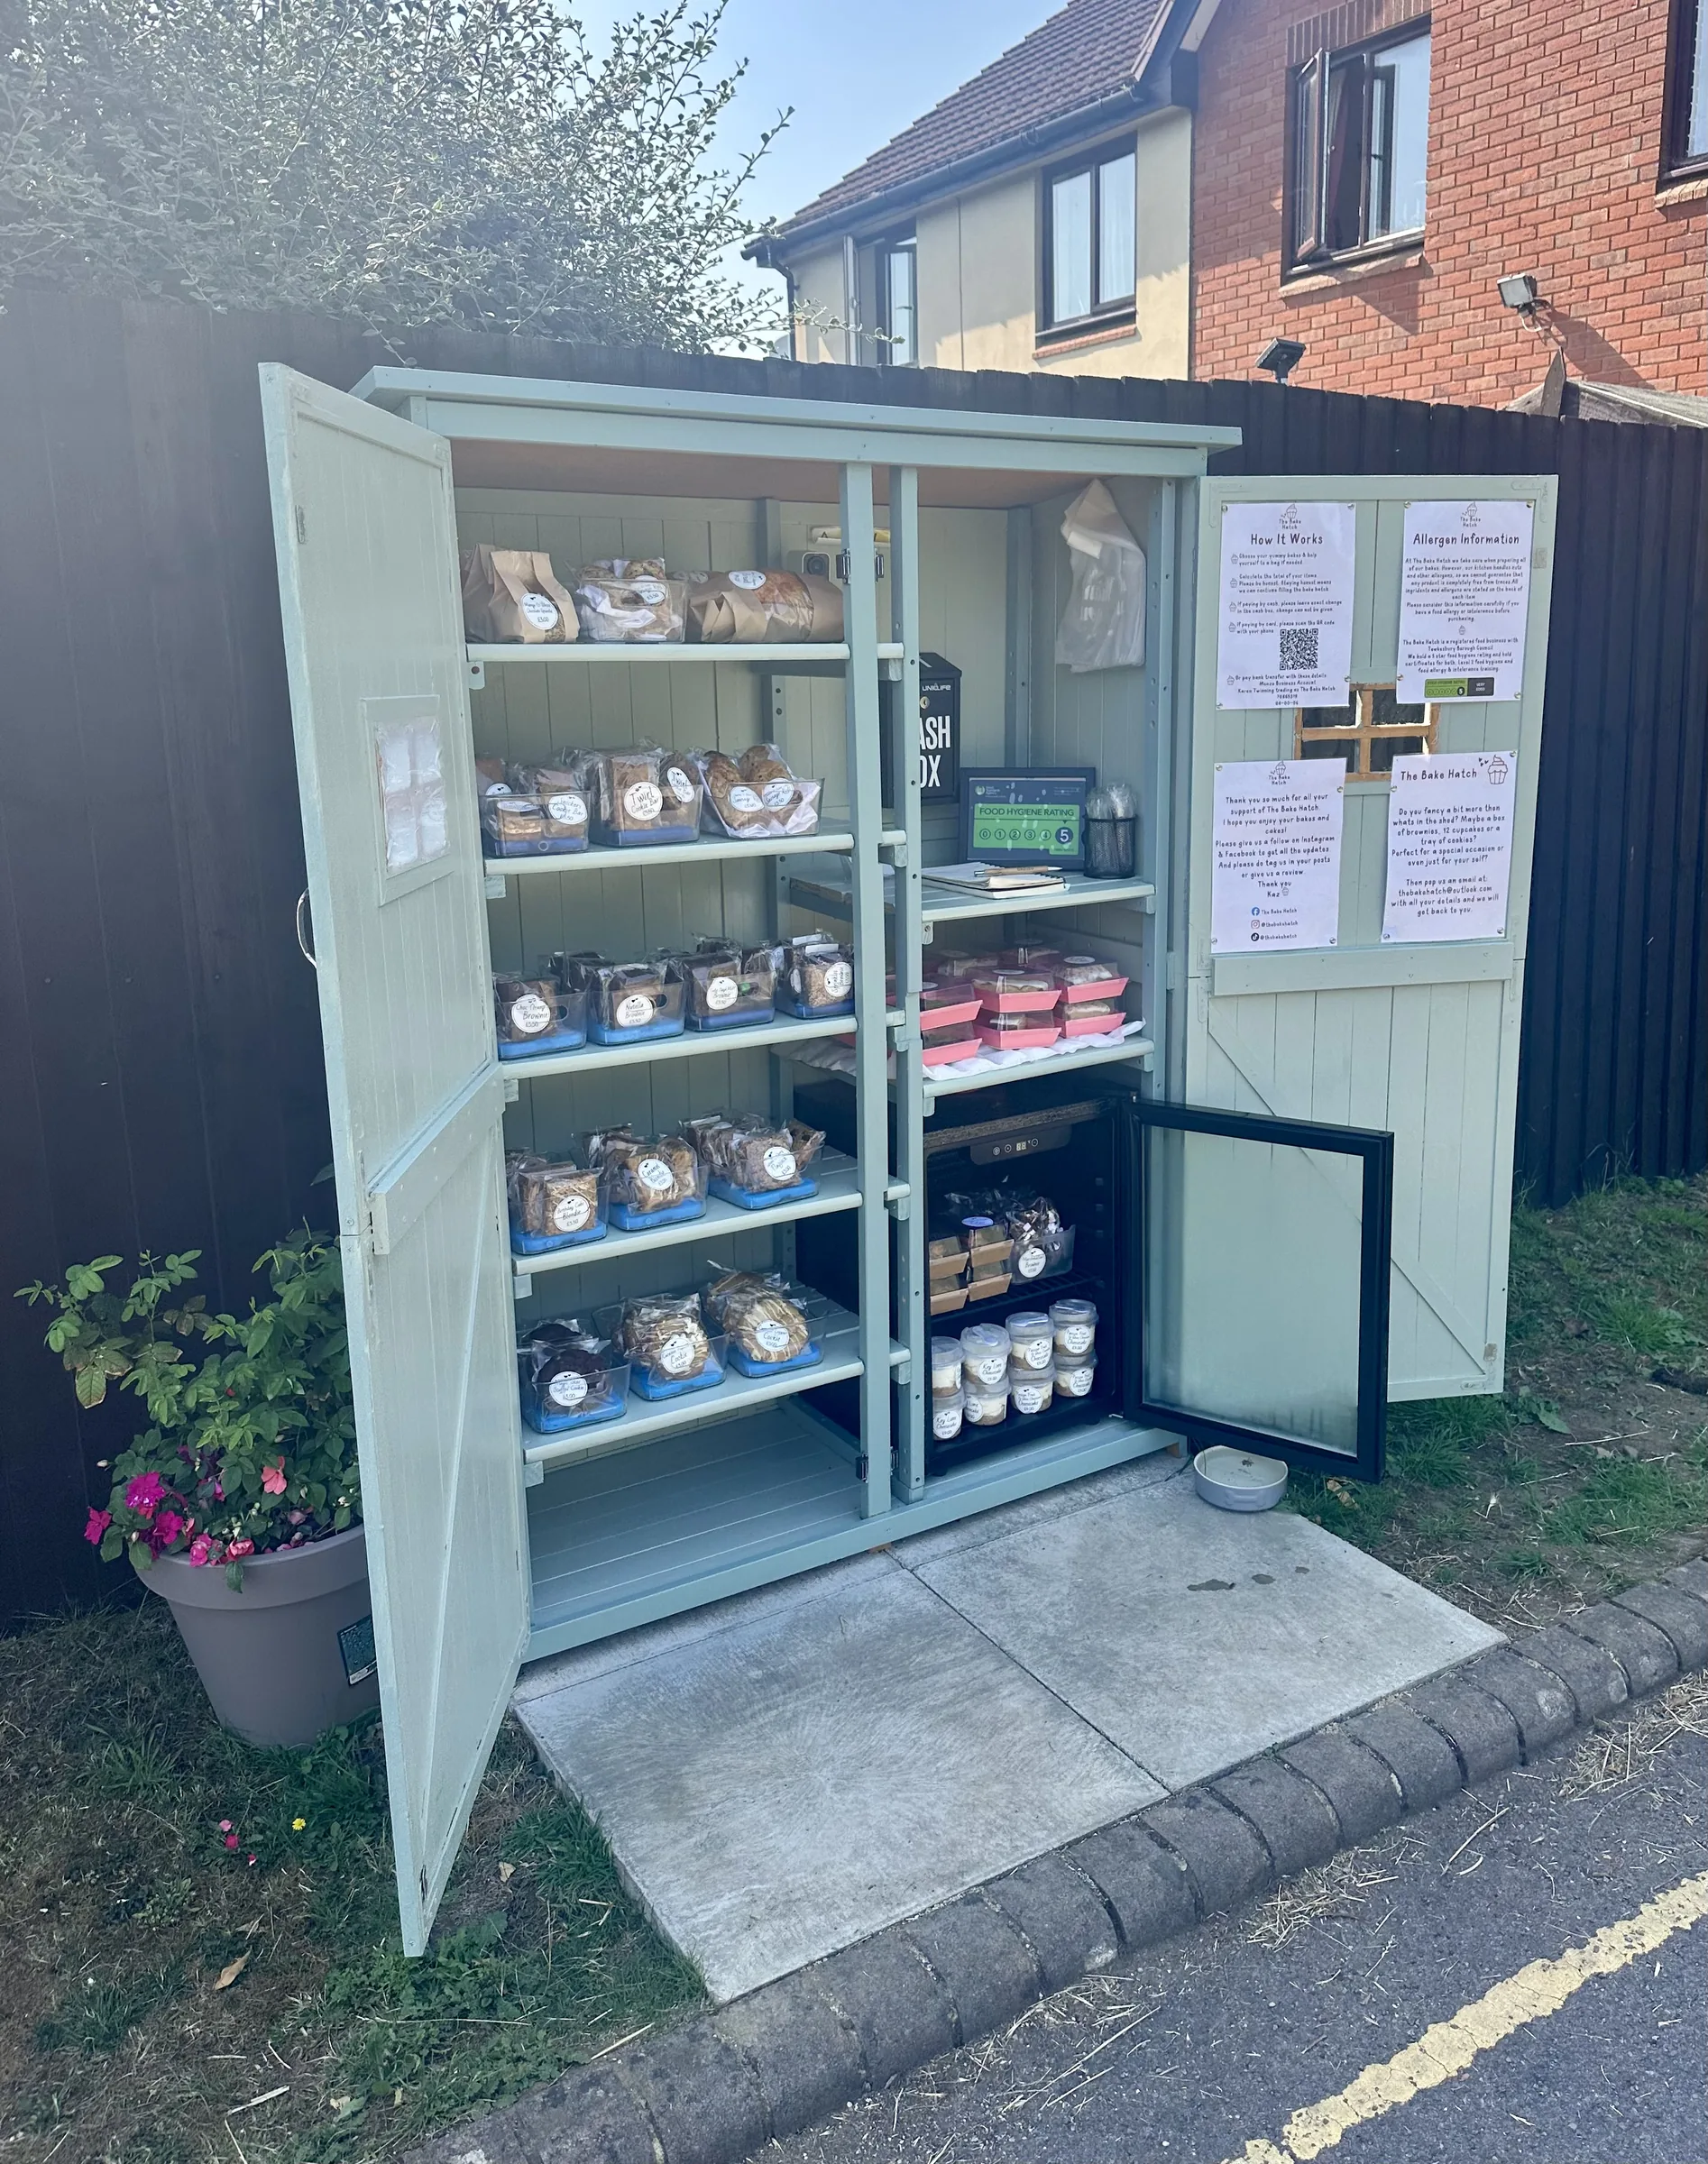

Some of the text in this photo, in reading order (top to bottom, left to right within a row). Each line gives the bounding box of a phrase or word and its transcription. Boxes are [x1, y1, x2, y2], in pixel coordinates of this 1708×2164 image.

[1251, 533, 1323, 546] How It Works
[1413, 532, 1520, 548] Allergen Information
[920, 716, 950, 749] ASH
[920, 755, 941, 788] OX
[1400, 768, 1477, 781] The Bake Hatch
[1226, 796, 1246, 804] Thank
[1272, 794, 1290, 802] much
[1291, 793, 1301, 802] for
[979, 807, 1005, 816] FOOD
[1006, 808, 1042, 816] HYGIENE
[1231, 807, 1256, 816] support
[1258, 806, 1266, 814] of
[1267, 805, 1279, 813] The
[1399, 808, 1408, 816] Do
[1424, 806, 1445, 815] fancy
[1453, 805, 1464, 813] bit
[1227, 819, 1243, 827] hope
[1296, 815, 1316, 823] bakes
[1318, 813, 1330, 821] and
[1392, 818, 1415, 826] whats
[1425, 817, 1437, 825] the
[1438, 815, 1459, 824] shed?
[1460, 814, 1485, 824] Maybe
[1060, 829, 1070, 842] 5
[1397, 828, 1406, 837] of
[1452, 825, 1484, 835] cupcakes
[1270, 837, 1290, 845] follow
[1301, 835, 1335, 844] Instagram
[1421, 835, 1477, 846] tray of cookies?
[1226, 849, 1256, 857] Facebook
[1258, 848, 1265, 857] to
[1267, 848, 1279, 857] get
[1290, 847, 1301, 855] the
[1391, 848, 1419, 857] Perfect
[1419, 848, 1430, 856] for
[1439, 846, 1464, 856] special
[1218, 861, 1232, 869] And
[1233, 861, 1254, 869] please
[1256, 859, 1263, 867] do
[1265, 859, 1278, 867] tag
[1296, 858, 1311, 867] your
[1313, 856, 1331, 866] posts
[1425, 857, 1440, 867] just
[1441, 857, 1452, 865] for
[1454, 857, 1470, 866] your
[1472, 854, 1489, 863] self?
[1250, 872, 1264, 880] give
[1406, 878, 1423, 886] Then
[1458, 876, 1476, 884] email
[1391, 899, 1407, 907] with
[1409, 898, 1418, 906] all
[1437, 896, 1461, 905] details
[1488, 894, 1499, 902] will
[1417, 907, 1429, 917] get
[1431, 907, 1447, 915] back
[1450, 906, 1457, 914] to
